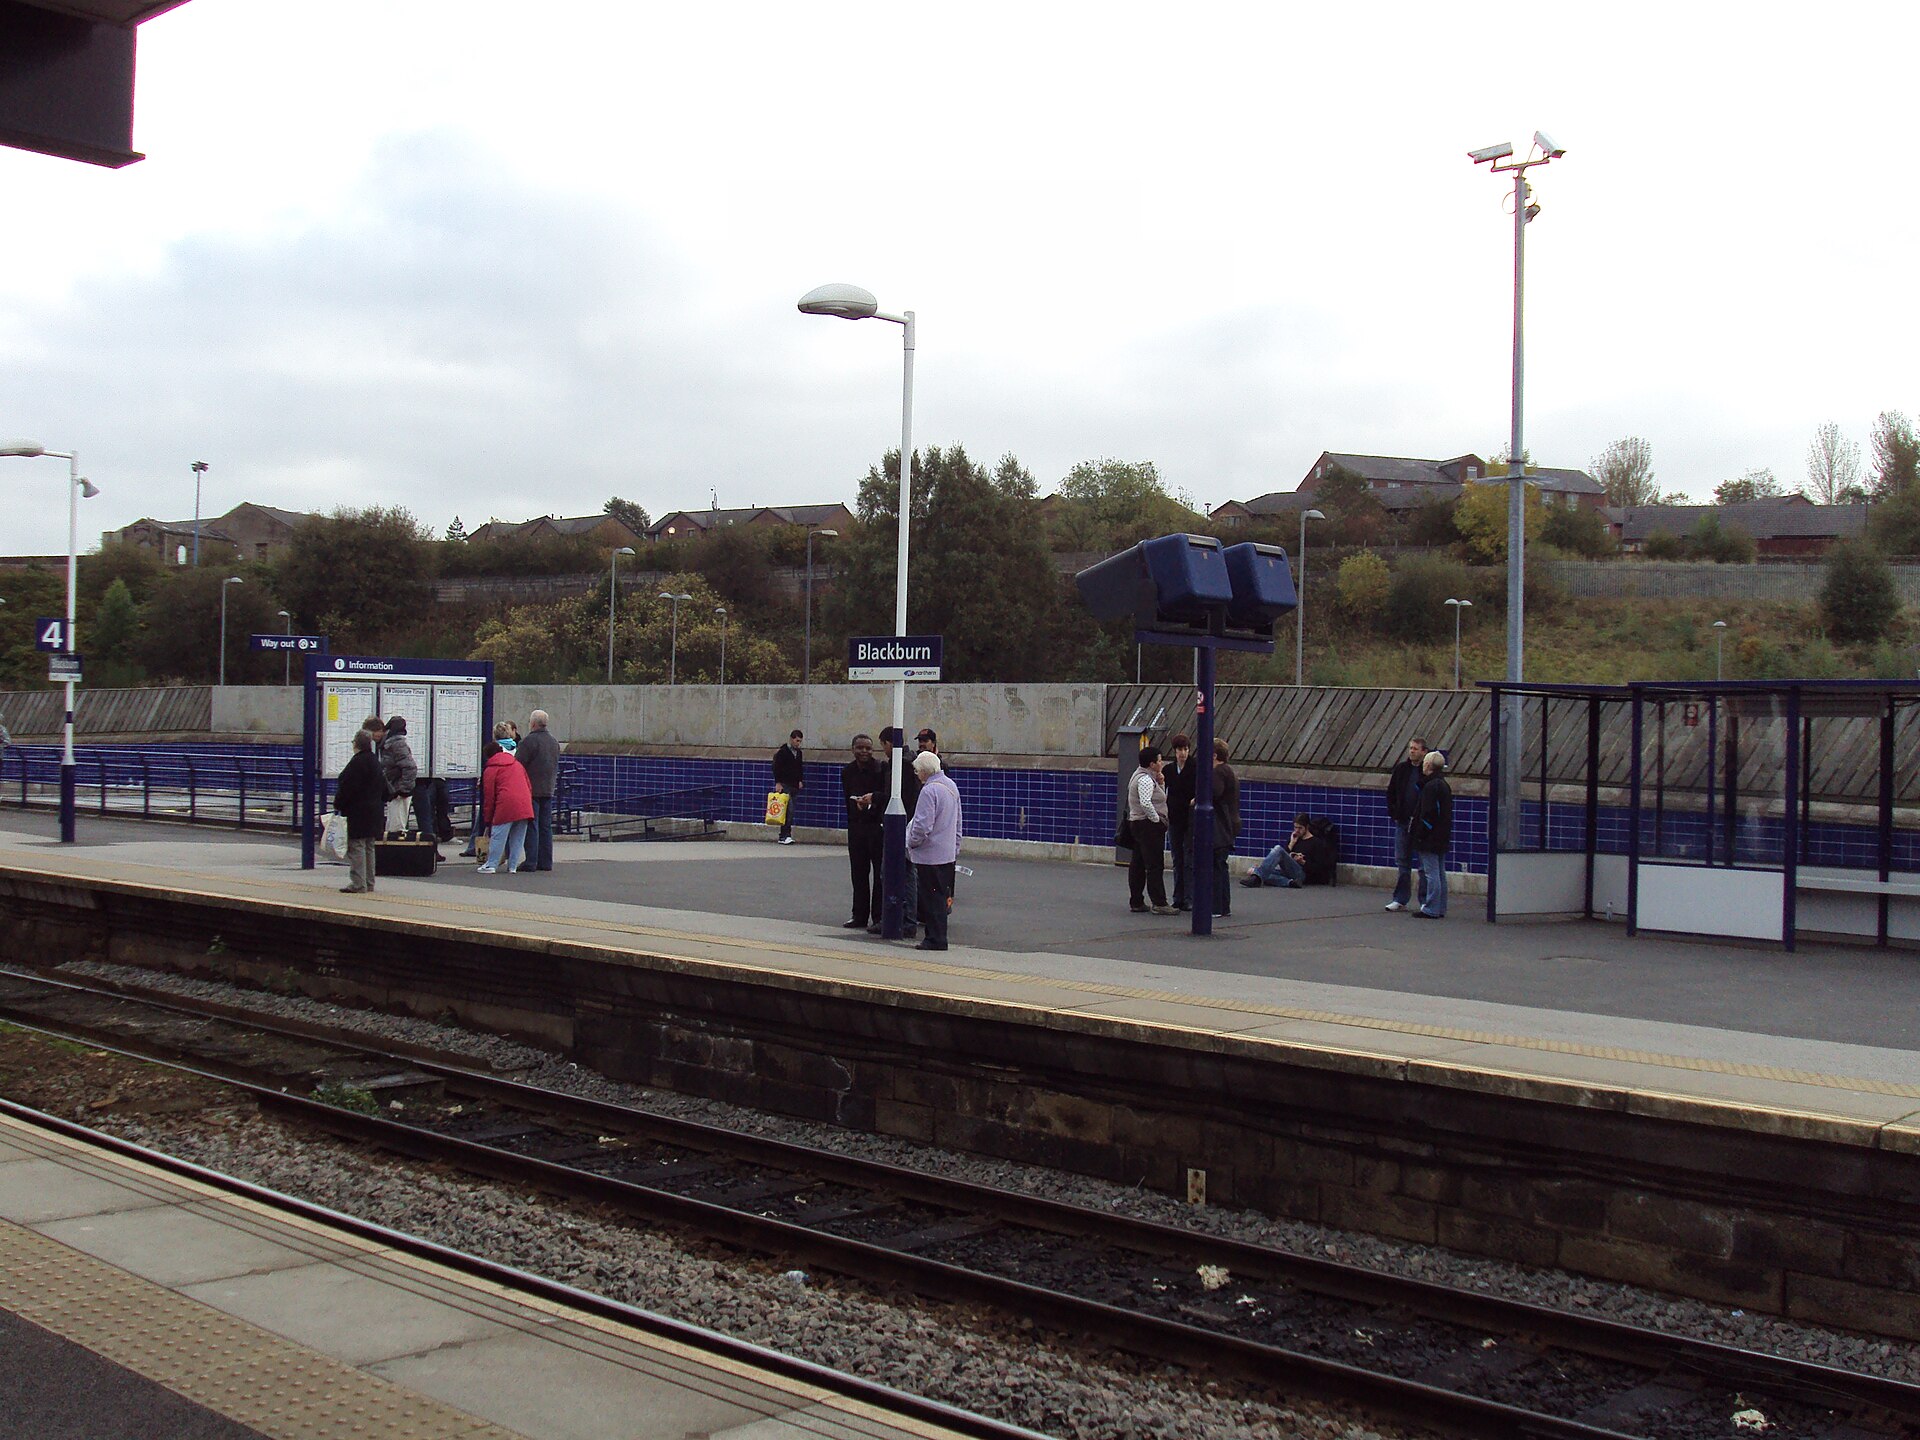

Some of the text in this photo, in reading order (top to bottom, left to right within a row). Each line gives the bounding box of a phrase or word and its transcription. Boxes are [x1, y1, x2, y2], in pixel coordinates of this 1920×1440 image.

[41, 621, 63, 648] 4
[261, 639, 295, 649] Way out
[858, 642, 931, 660] Blackburn
[349, 661, 393, 670] Information
